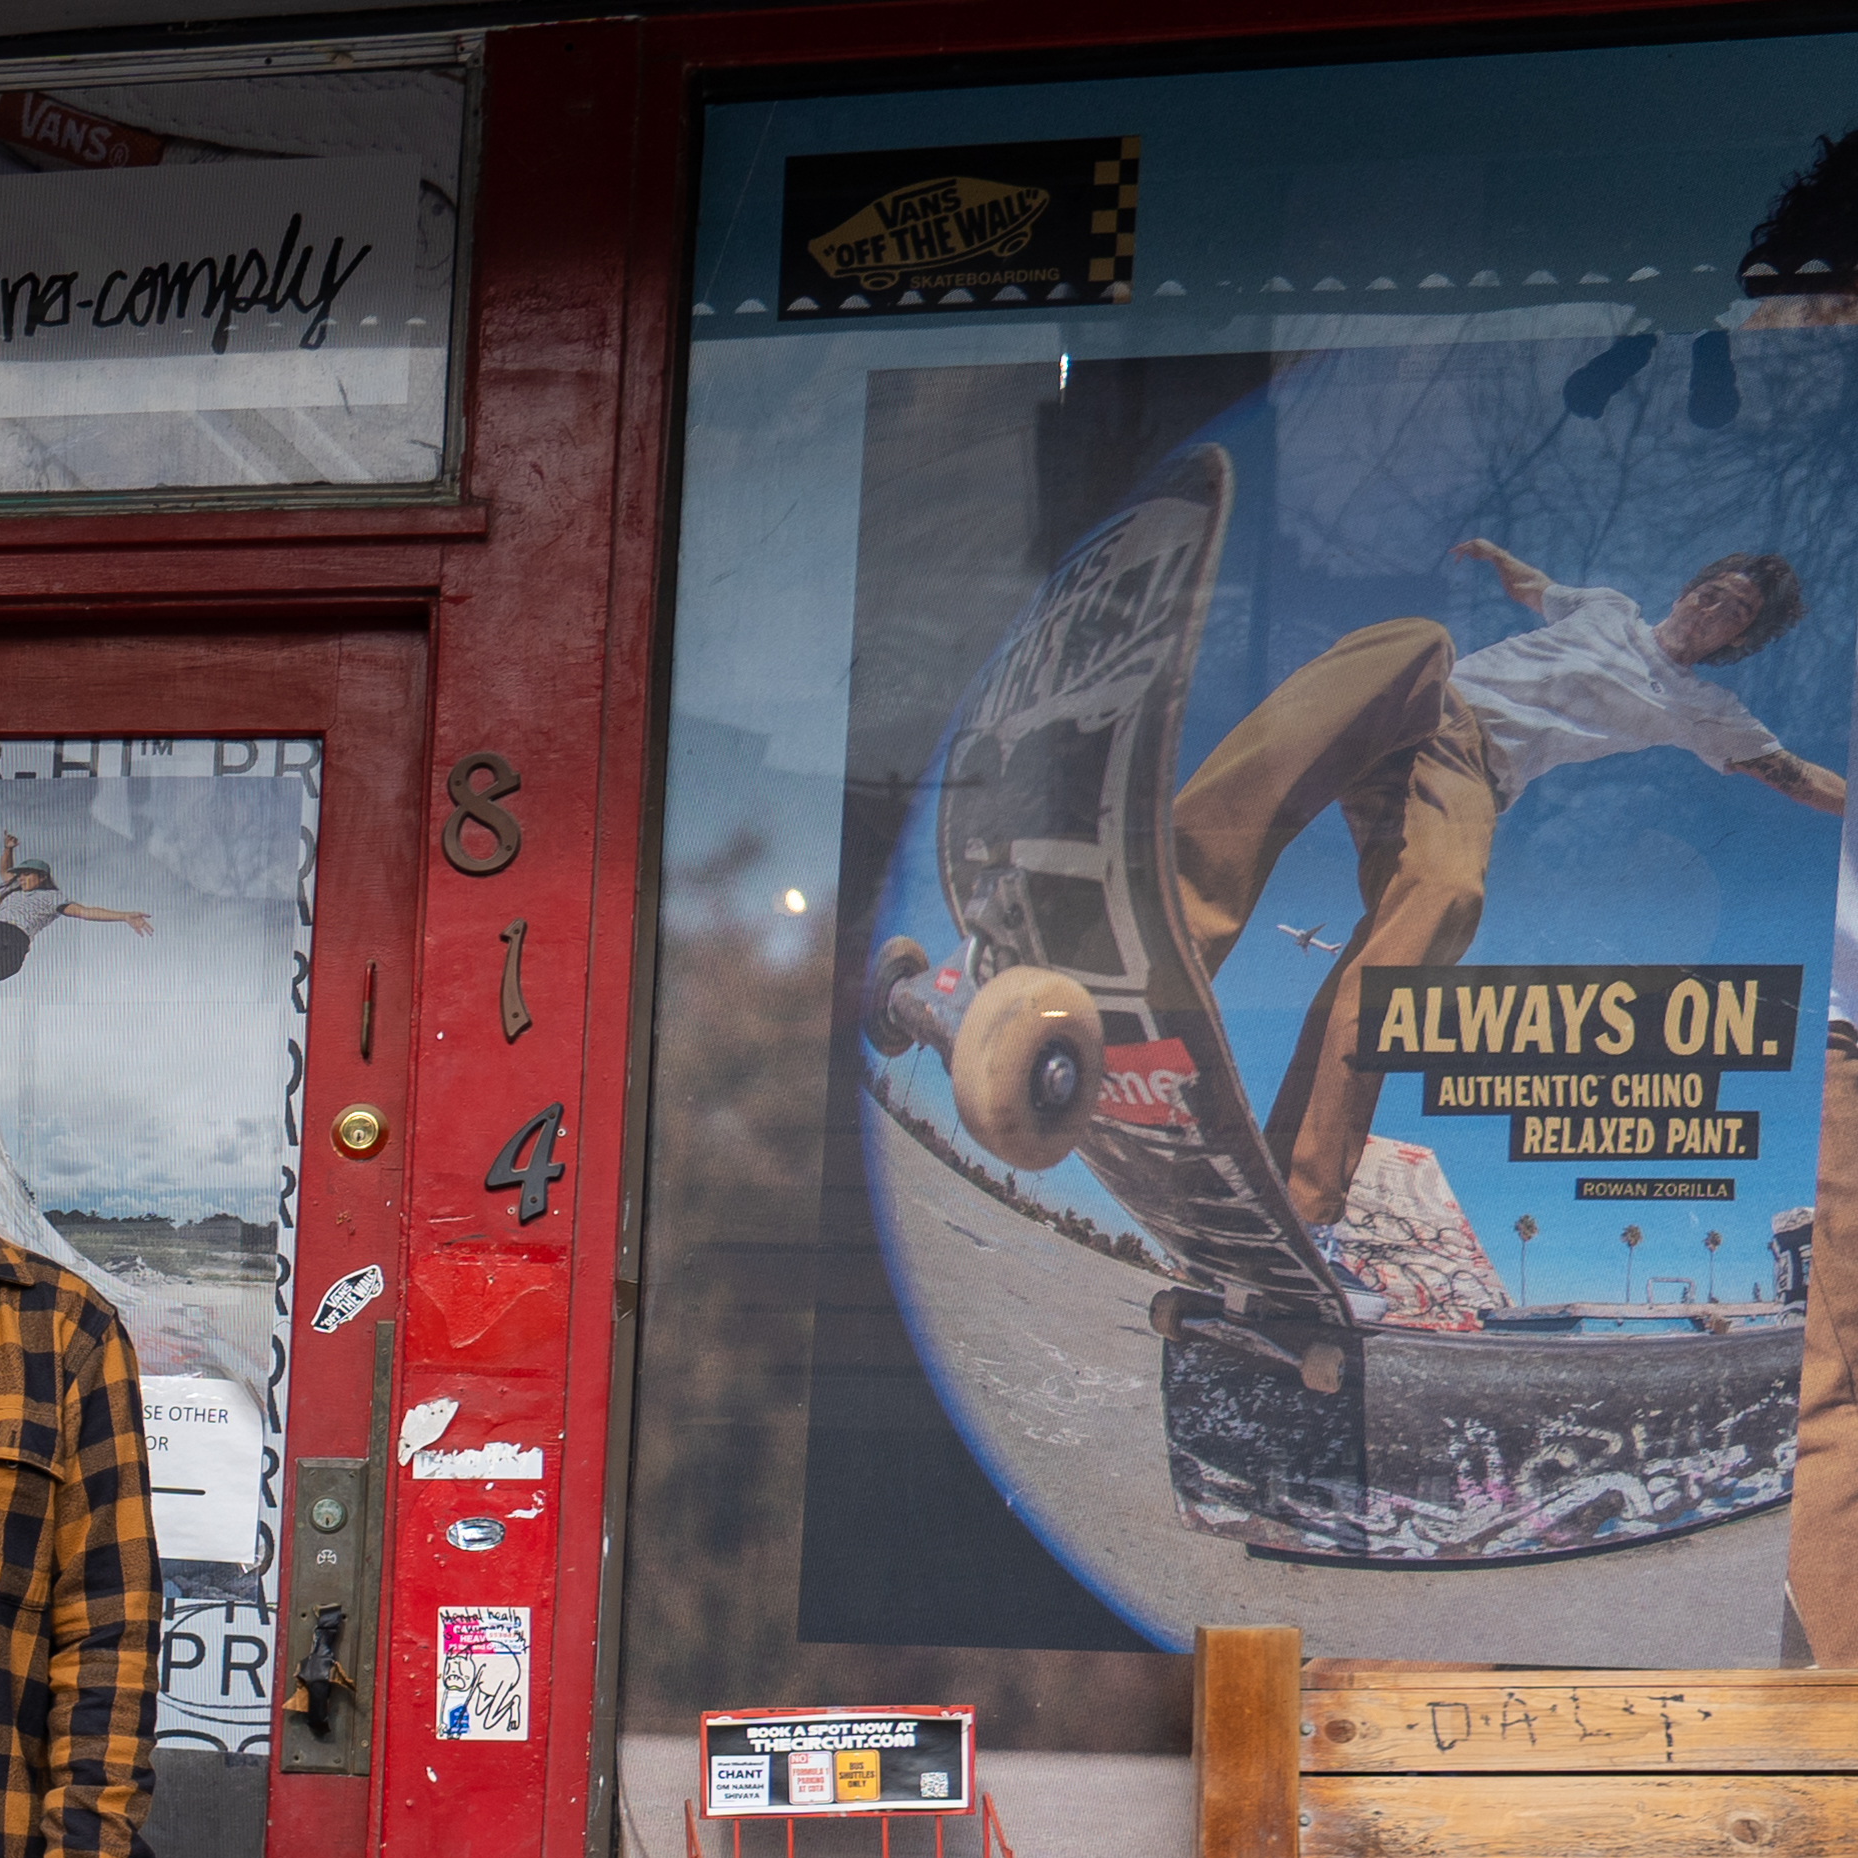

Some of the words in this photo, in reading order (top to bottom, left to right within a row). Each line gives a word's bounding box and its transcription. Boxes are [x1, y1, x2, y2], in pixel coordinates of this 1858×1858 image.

[874, 179, 961, 229] VANS
[890, 221, 955, 261] THE
[1, 212, 373, 355] no-comply
[909, 267, 1061, 289] SKATEBOARDING
[1377, 979, 1638, 1055] ALWAYS
[1663, 978, 1779, 1056] ON.
[1611, 1073, 1703, 1108] CHINO
[1522, 1117, 1655, 1155] RELAXED
[1666, 1117, 1747, 1155] PANT.
[1583, 1182, 1648, 1198] ROWAN
[1653, 1182, 1729, 1198] ZORILLA
[168, 1405, 229, 1425] OTHER
[746, 1726, 791, 1740] BOOK
[793, 1725, 806, 1738] A
[807, 1723, 851, 1737] SPOT
[851, 1722, 892, 1735] NOW
[892, 1721, 918, 1733] AT
[750, 1733, 916, 1753] THECIRCUIT.COM
[790, 1754, 808, 1764] NO
[849, 1762, 865, 1771] BUS
[717, 1769, 764, 1780] CHANT
[838, 1771, 876, 1780] SHUTTLES
[848, 1779, 867, 1788] ONLY
[716, 1783, 731, 1791] OM
[731, 1783, 765, 1791] NAMAH
[724, 1792, 761, 1800] SHIVAYA
